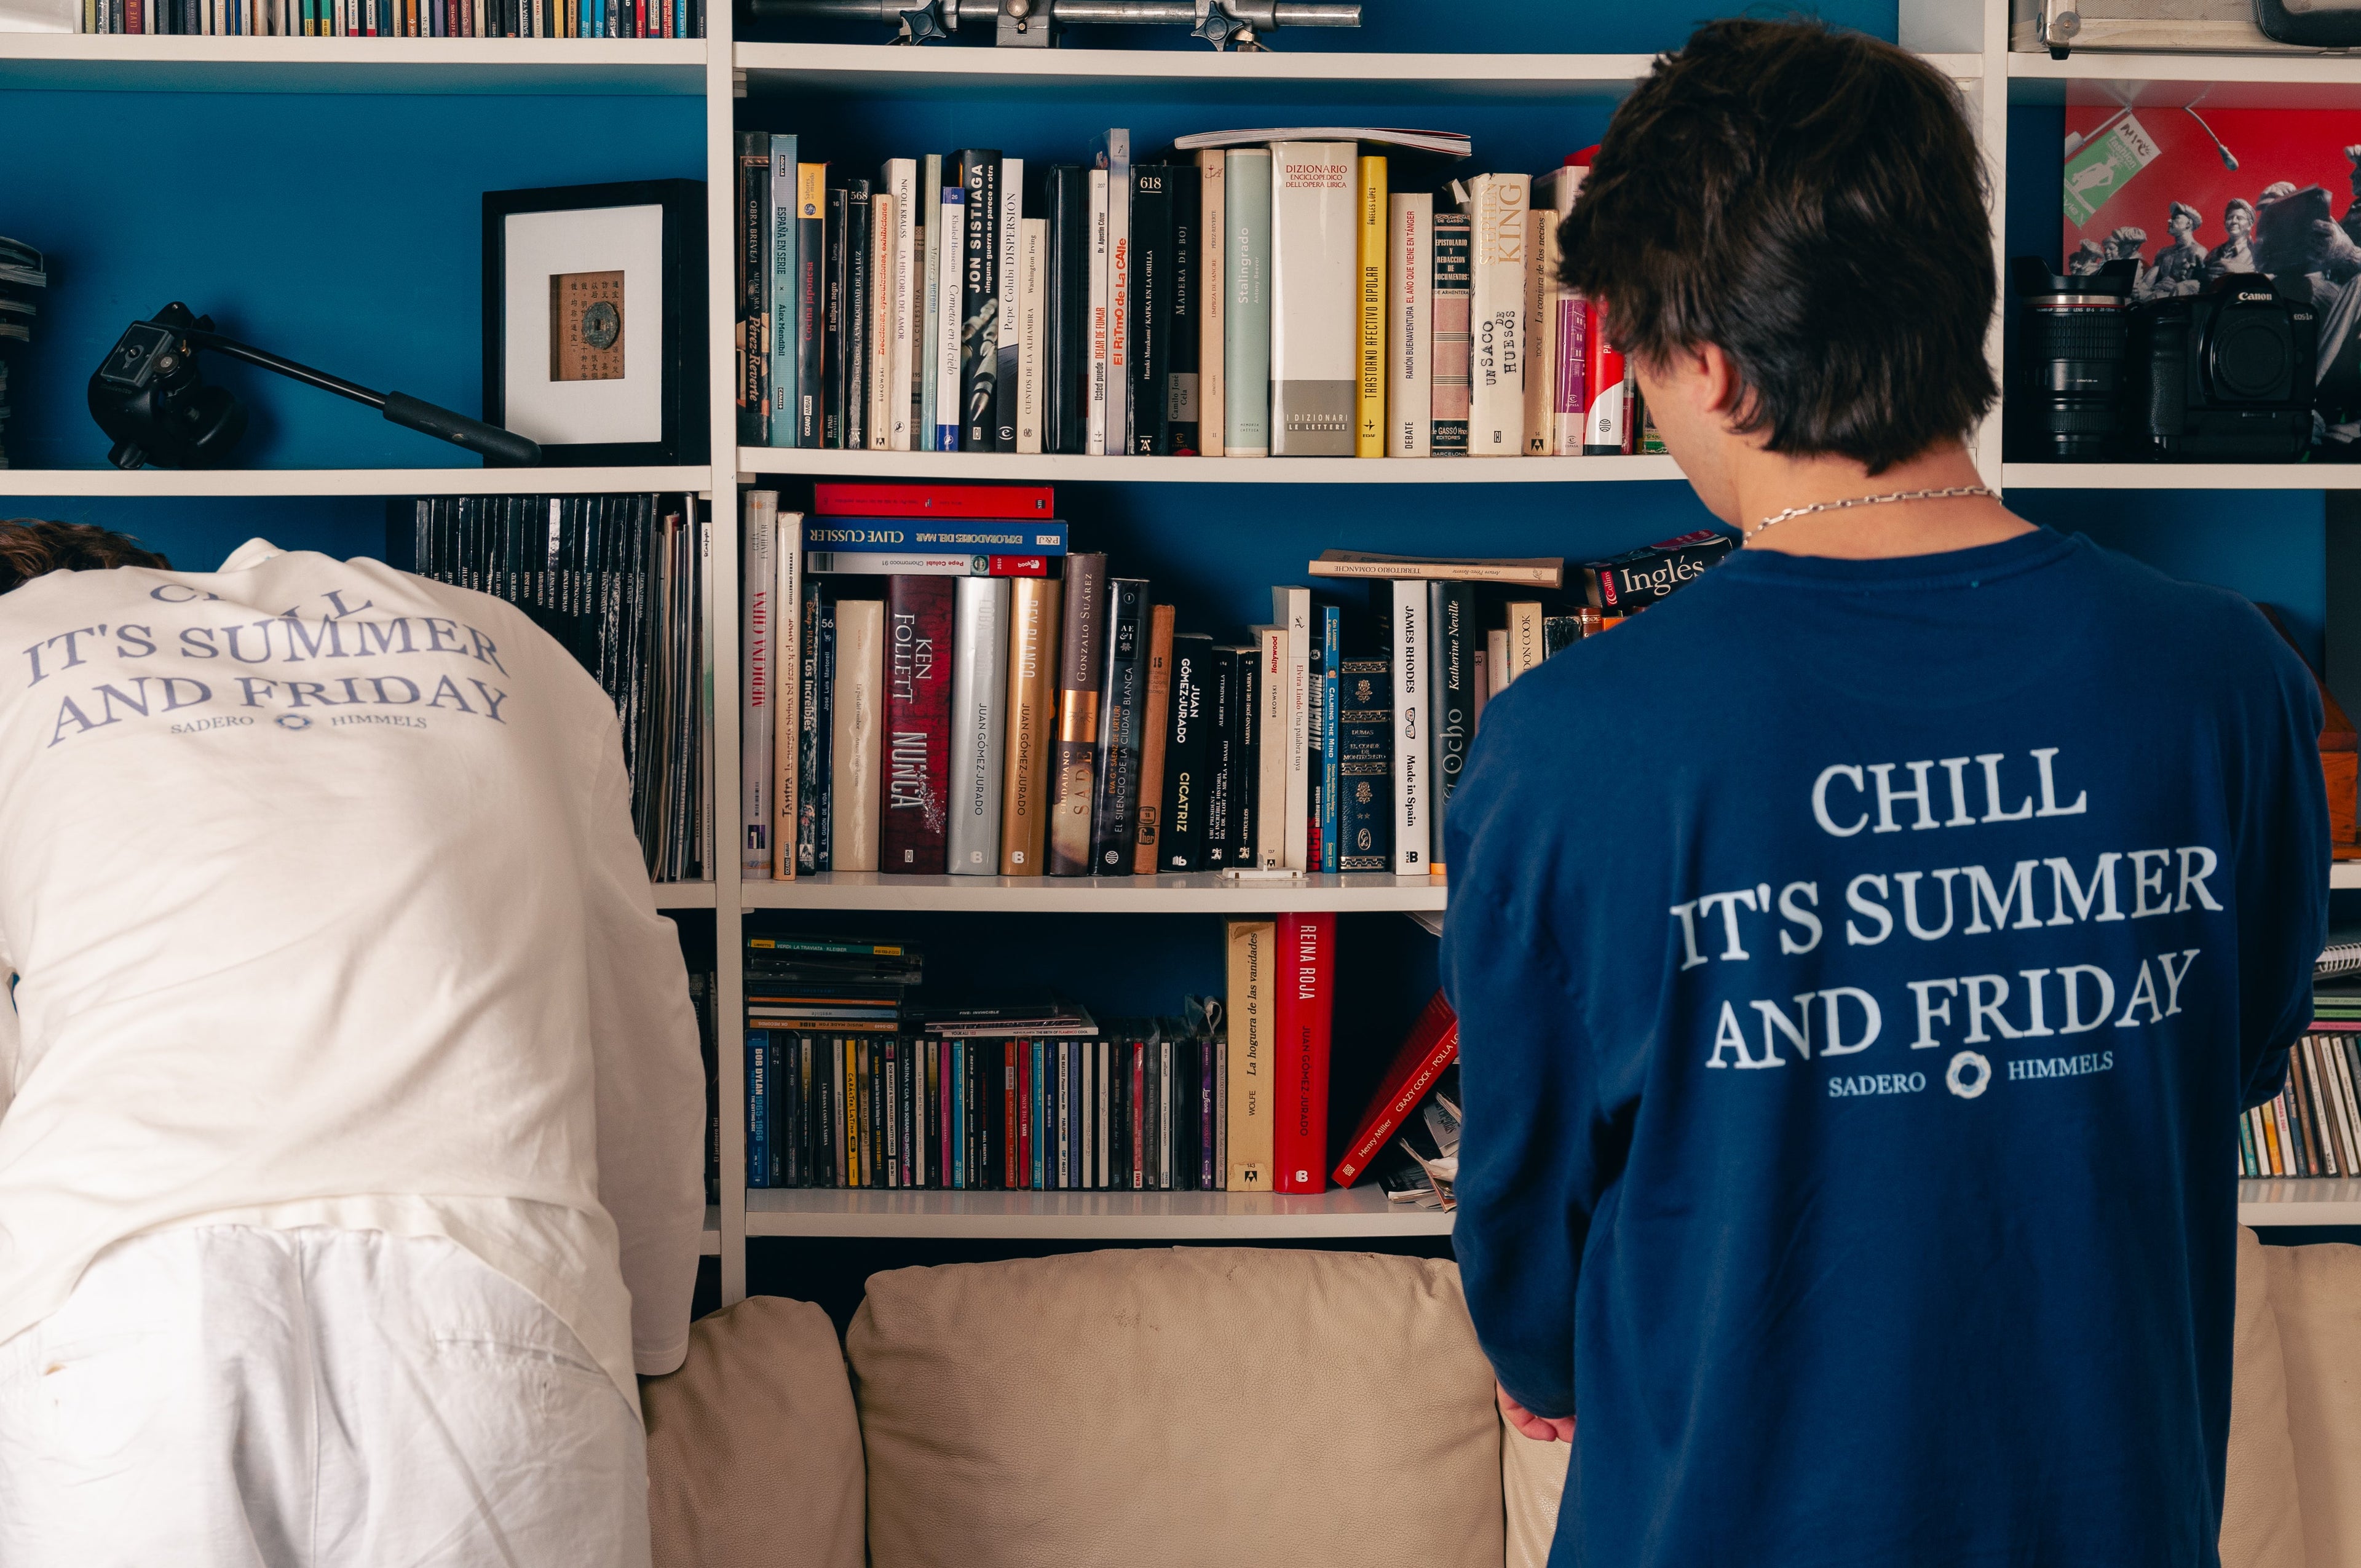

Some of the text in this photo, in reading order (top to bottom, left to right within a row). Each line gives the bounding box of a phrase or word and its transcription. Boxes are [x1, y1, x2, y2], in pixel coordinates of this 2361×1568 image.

[1140, 177, 1161, 189] 618
[1286, 165, 1347, 173] DIZIONARIO
[850, 191, 868, 200] 568
[777, 207, 788, 274] ESPAÑA EN SERIE
[970, 164, 983, 293] JON SISTIAGA
[986, 221, 992, 231] se
[1178, 226, 1187, 244] BOJ
[1405, 211, 1415, 236] TÁNGER
[1498, 183, 1522, 264] KING
[899, 250, 906, 259] LA
[1004, 192, 1016, 330] Pepe Colubi DISPERSIÓN
[1178, 250, 1185, 263] DE
[1238, 227, 1251, 303] Stalingrado
[1406, 247, 1415, 265] VIENE
[1406, 267, 1415, 280] QUE
[804, 261, 815, 341] Cocina japonesa
[1404, 281, 1415, 295] AÑO
[2238, 291, 2272, 301] Canon
[947, 285, 959, 375] Cometas en el cielo
[1096, 307, 1105, 328] FUMAR
[1364, 266, 1378, 399] TRASTORNO AFECTIVO BIPOLAR
[1495, 311, 1504, 326] DE
[749, 315, 761, 402] Pérez-Reverte
[1095, 340, 1105, 359] DEJAR
[1481, 321, 1496, 386] UN SACO
[1504, 310, 1517, 374] HUESOS
[1094, 362, 1104, 381] puede
[1404, 357, 1414, 379] RAMÓN
[1094, 383, 1103, 400] Usted
[1404, 422, 1414, 449] DEBATE
[810, 529, 904, 543] CLIVE CUSSLER
[916, 533, 1022, 544] EXPLORADORES DEL MAR
[1604, 572, 1615, 598] Collins
[1620, 555, 1705, 596] Inglés
[22, 616, 511, 688] IT'S SUMMER
[752, 591, 767, 707] MEDICINA CHINA
[892, 613, 915, 704] FOLLETT
[915, 638, 933, 679] KEN
[1406, 606, 1415, 693] JAMES RHODES
[1449, 600, 1459, 691] Katherine Neville
[1123, 668, 1133, 705] BLANCA
[1177, 658, 1192, 743] GÓMEZ-JURADO
[1190, 684, 1200, 717] JUAN
[47, 675, 508, 748] AND FRIDAY
[171, 714, 428, 734] SADERO HIMMELS
[1120, 709, 1130, 744] CIUDAD
[975, 703, 987, 815] JUAN GÓMEZ-JURADO
[1017, 703, 1030, 815] JUAN GÓMEZ-JURADO
[1118, 748, 1128, 758] LA
[1294, 728, 1303, 754] palabra
[890, 732, 928, 809] NUNCA
[1060, 751, 1070, 814] CIUDADANO
[1073, 751, 1093, 815] SADE
[1118, 762, 1126, 773] DE
[1115, 777, 1126, 820] SILENCIO
[1176, 772, 1190, 832] CICATRIZ
[1406, 755, 1416, 826] Made in Spain
[1811, 747, 2087, 837] CHILL
[1669, 845, 2223, 972] IT'S SUMMER
[1299, 925, 1316, 999] REINA ROJA
[1247, 933, 1258, 1076] La hoguera de las vanidades
[1706, 949, 2201, 1071] AND FRIDAY
[1299, 1025, 1311, 1136] JUAN GÓMEZ-JURADO
[1395, 1045, 1453, 1112] CRAZY COCK POLLA
[1829, 1051, 2114, 1098] SADERO HIMMELS
[1358, 1119, 1391, 1157] Henry Miller
